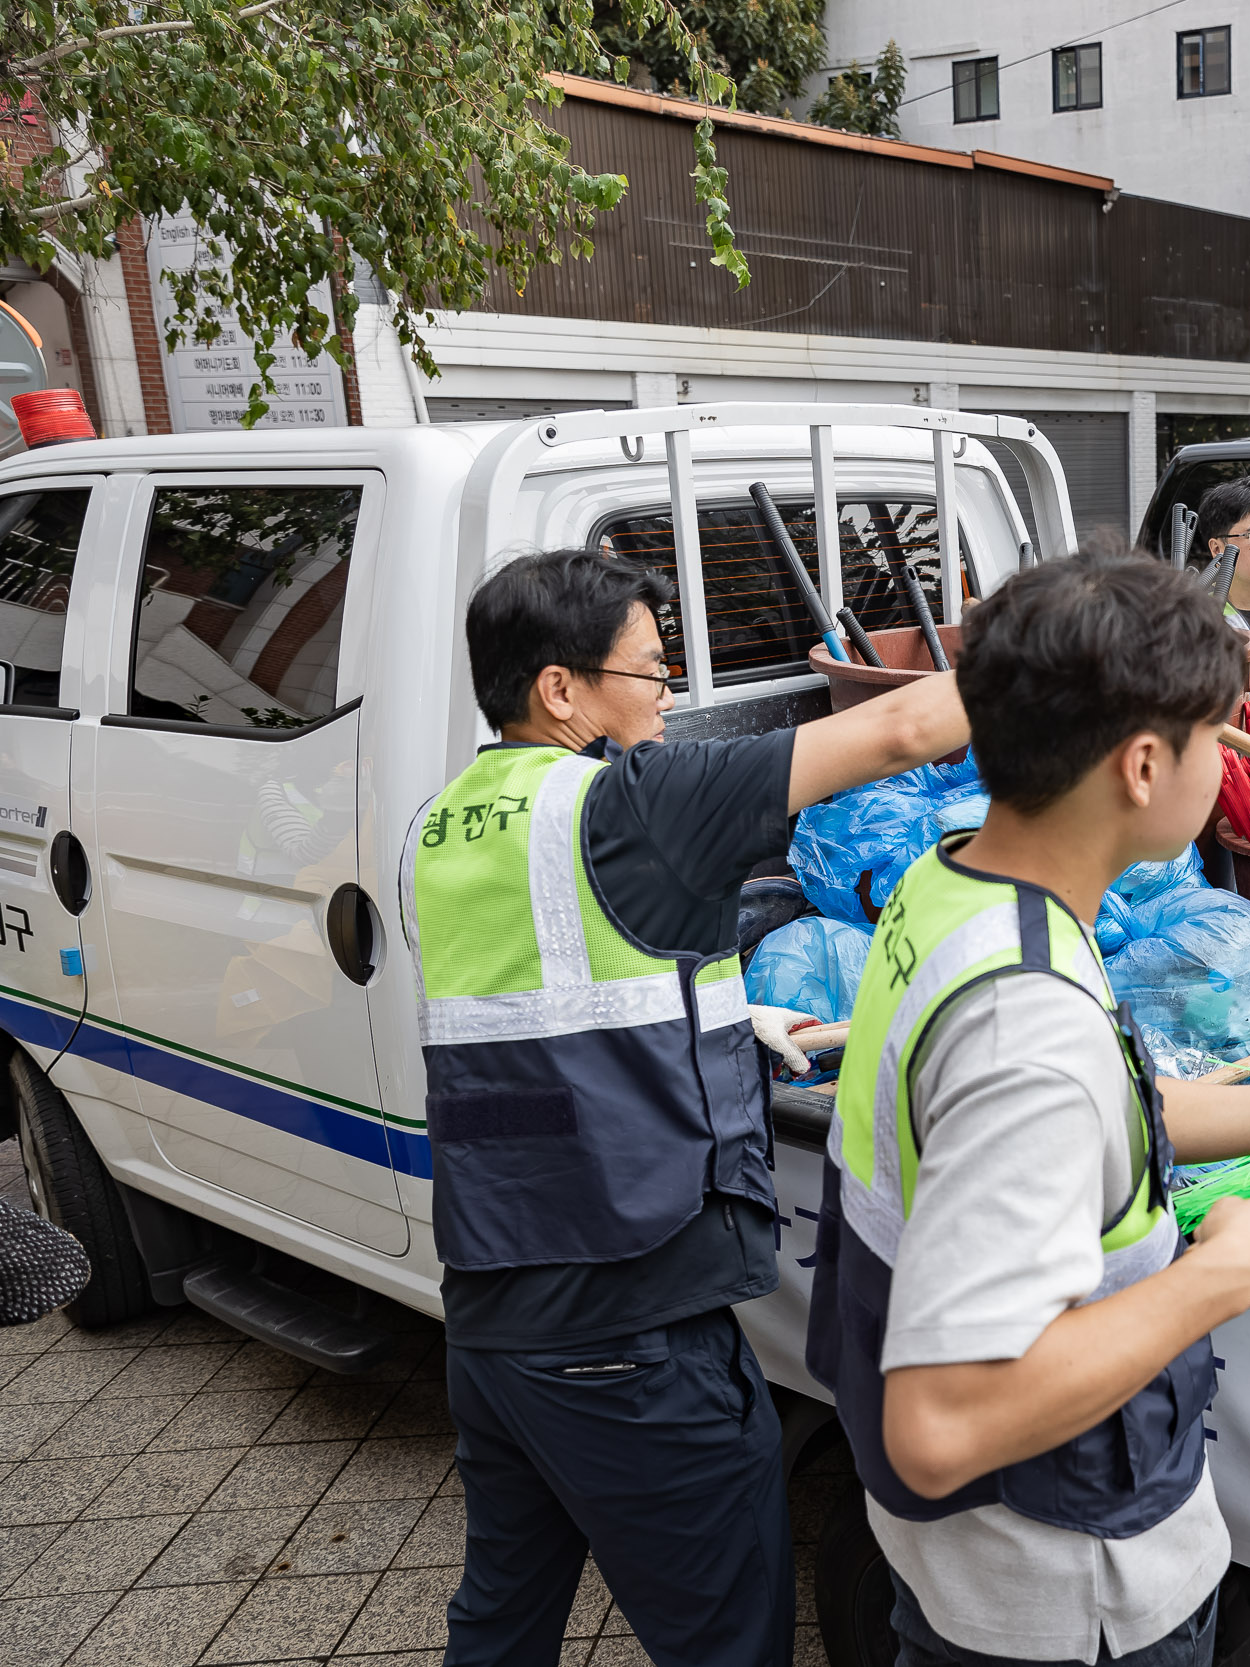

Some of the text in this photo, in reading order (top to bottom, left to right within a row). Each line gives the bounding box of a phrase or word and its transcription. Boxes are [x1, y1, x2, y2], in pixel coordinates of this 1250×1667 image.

[161, 226, 191, 242] English
[295, 382, 322, 396] 11:00
[298, 408, 325, 422] 11:30
[422, 793, 529, 848] 광진구
